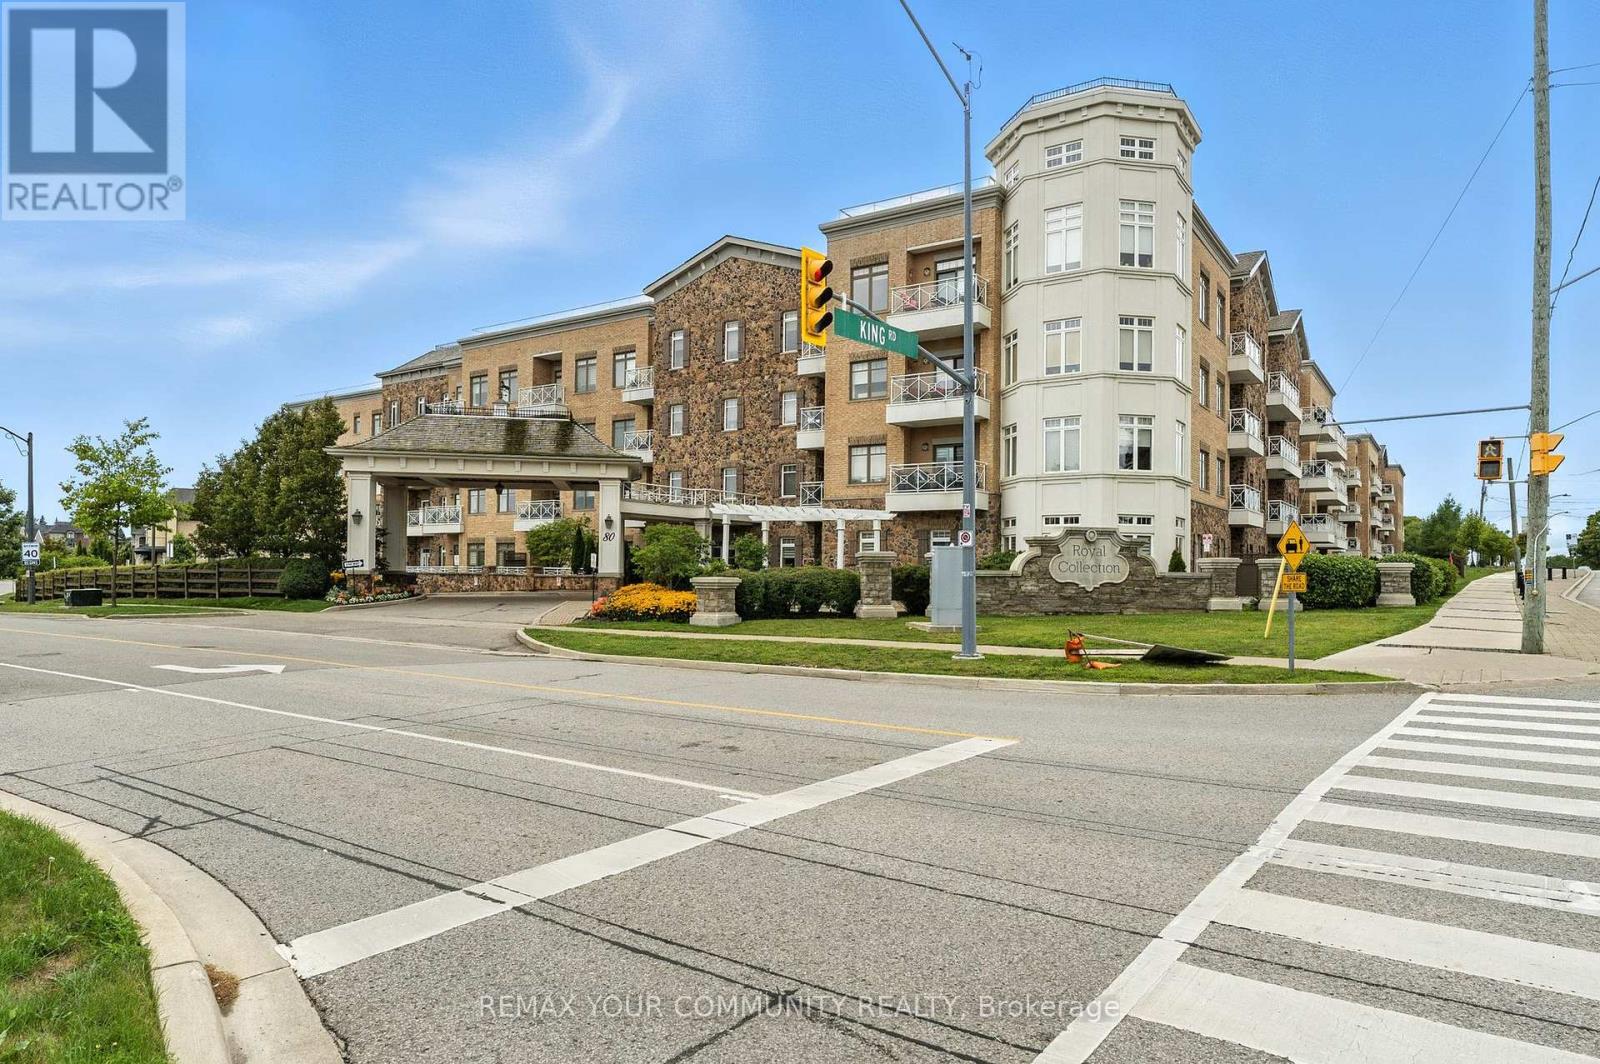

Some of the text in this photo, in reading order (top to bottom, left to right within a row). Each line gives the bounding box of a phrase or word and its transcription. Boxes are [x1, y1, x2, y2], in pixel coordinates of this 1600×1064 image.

[860, 320, 897, 345] KING RD
[603, 531, 616, 541] 80
[23, 549, 38, 558] 40
[1073, 544, 1106, 559] Royal
[1058, 560, 1120, 574] Collection
